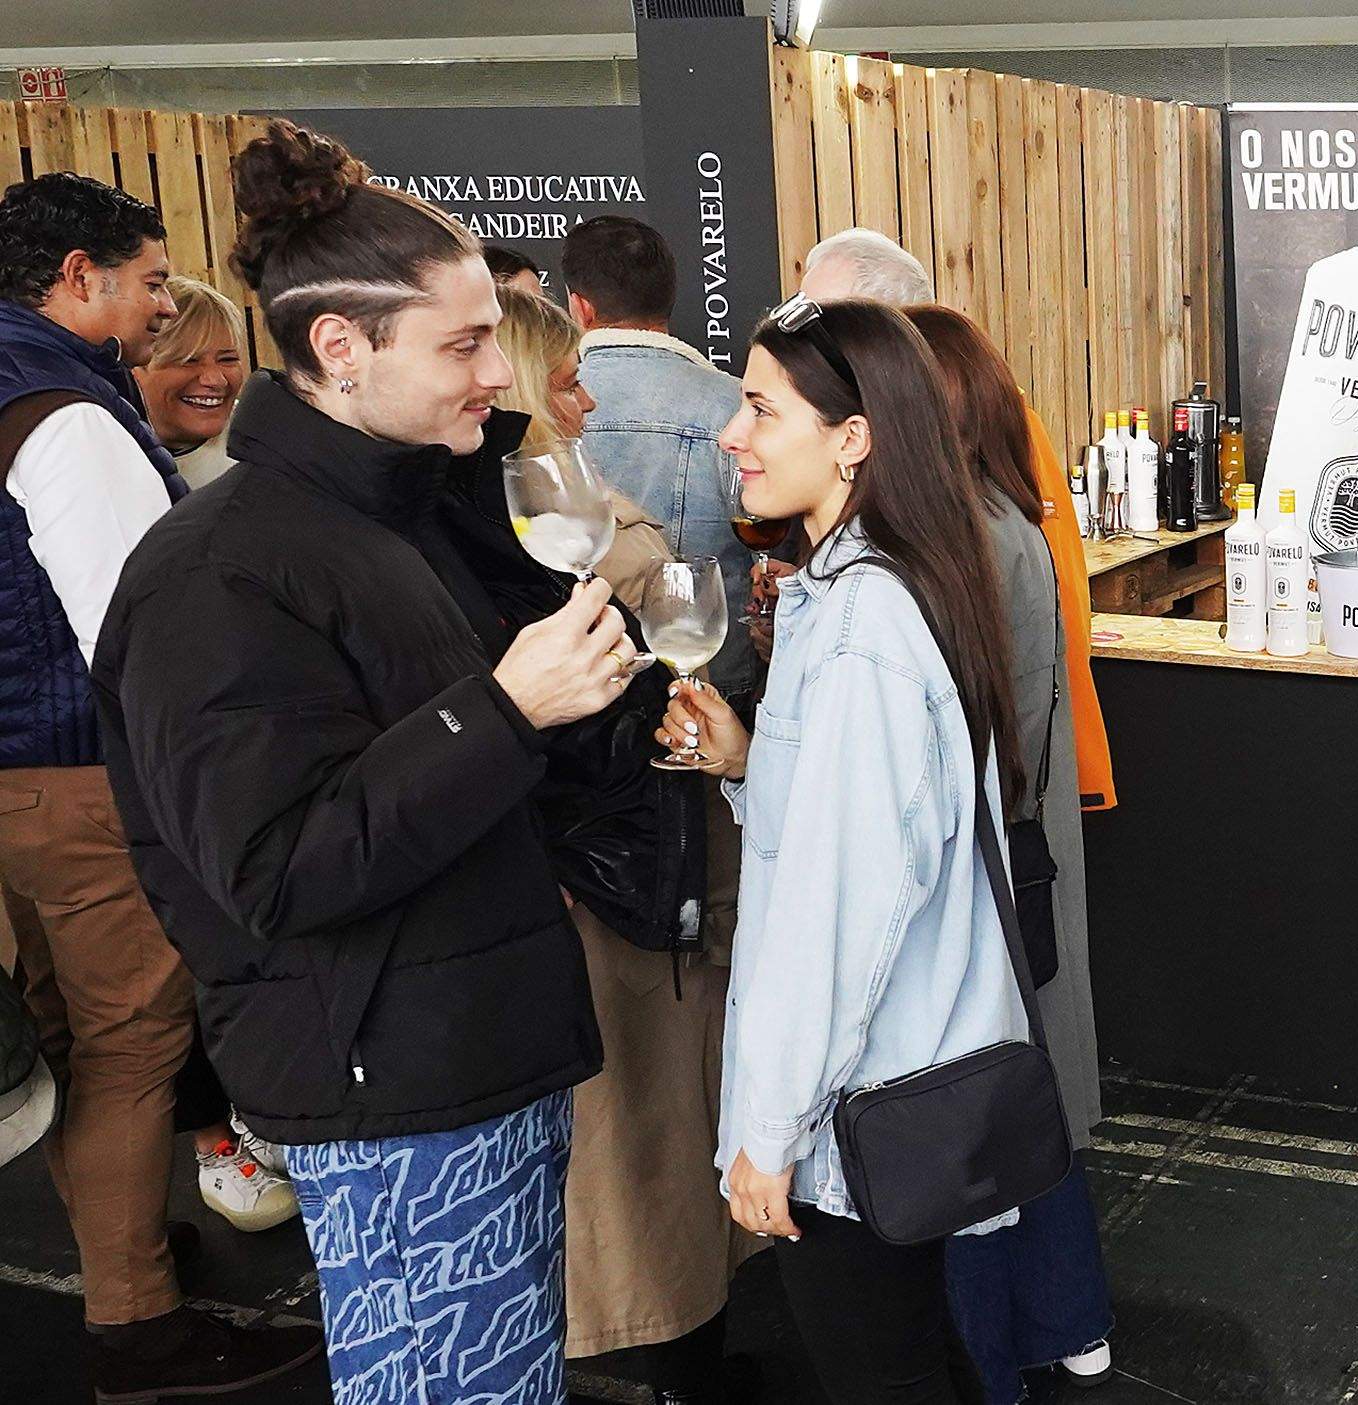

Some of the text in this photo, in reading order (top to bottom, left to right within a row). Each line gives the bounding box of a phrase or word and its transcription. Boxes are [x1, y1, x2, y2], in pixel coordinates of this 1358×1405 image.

[1240, 129, 1262, 169] O
[487, 174, 646, 202] EDUCATIVA
[697, 151, 731, 340] POVARELO
